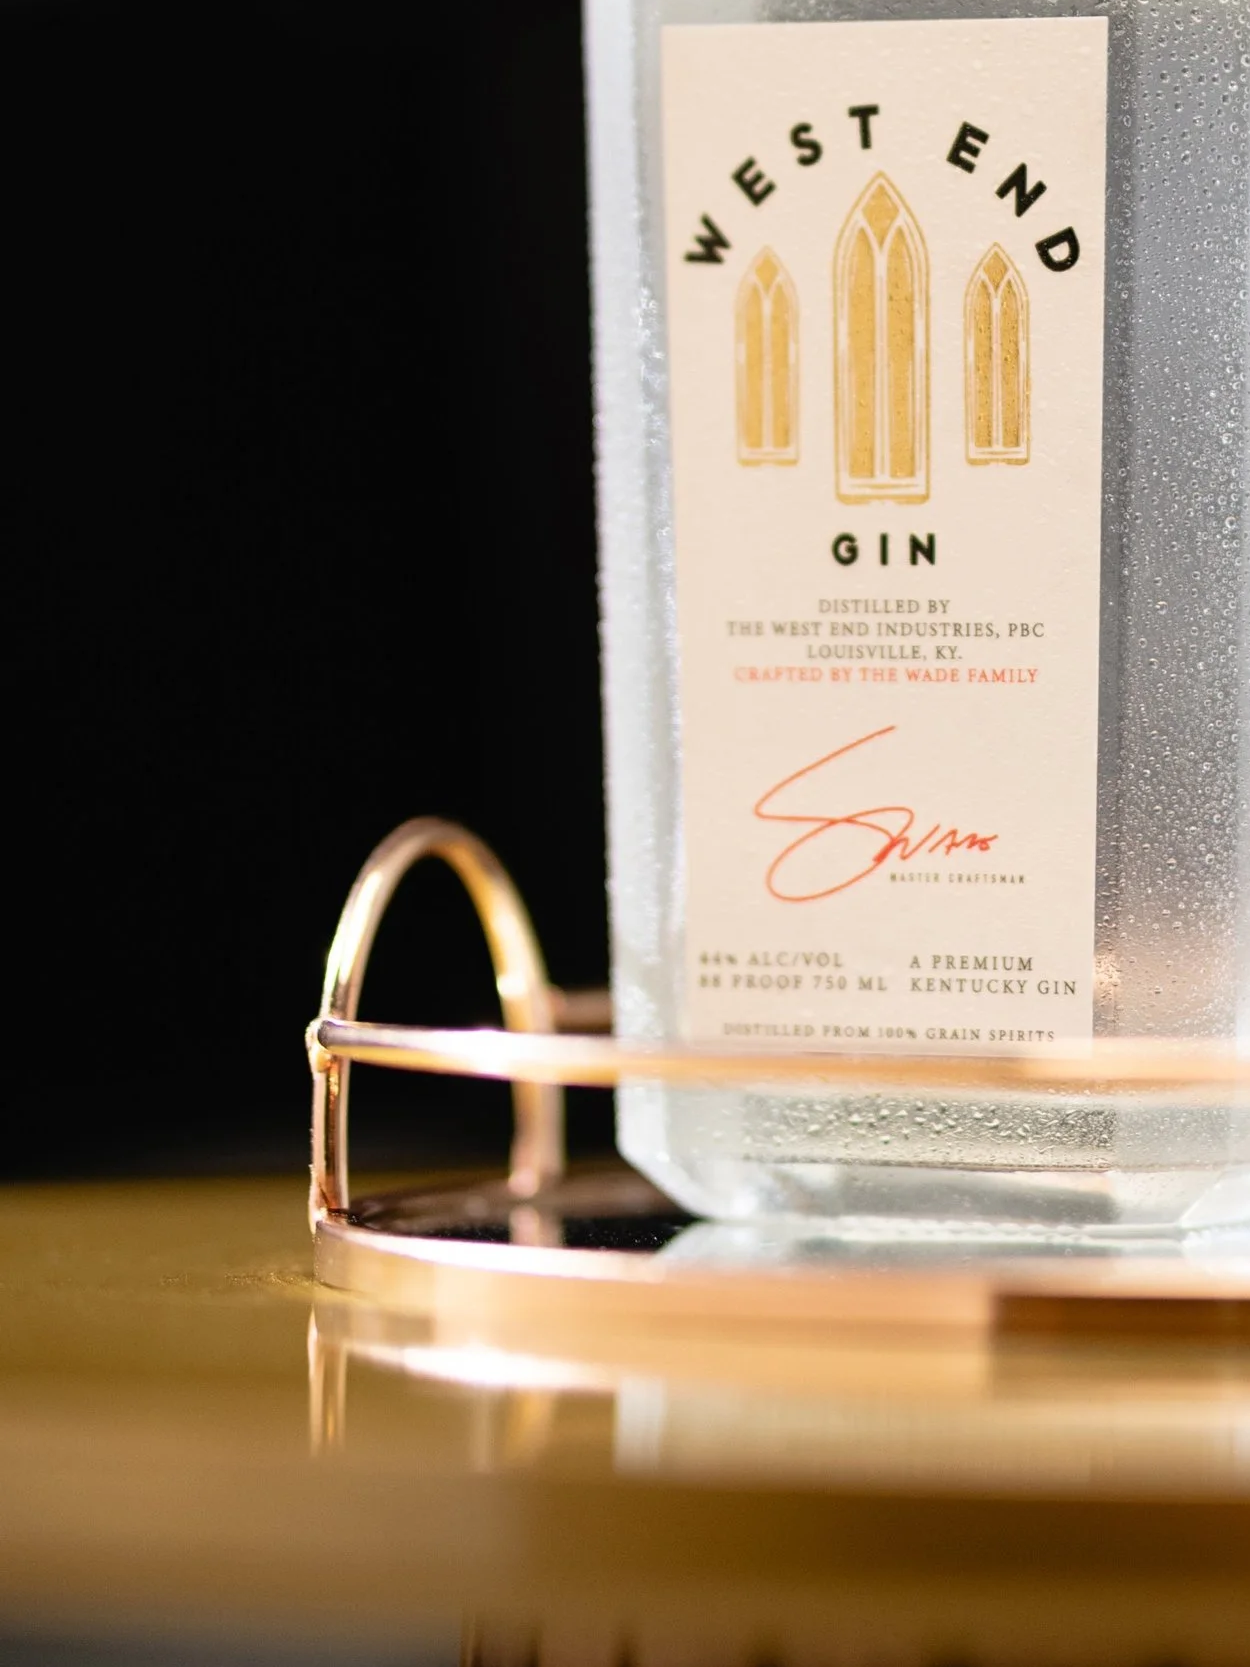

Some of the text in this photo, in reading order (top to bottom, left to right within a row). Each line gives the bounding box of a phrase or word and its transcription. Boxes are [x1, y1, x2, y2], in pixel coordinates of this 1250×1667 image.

[684, 103, 1081, 273] WEST END
[831, 532, 937, 566] GIN
[818, 599, 950, 614] DISTILLED BY
[727, 621, 1045, 640] THE WEST END INDUSTRIES, PBC
[807, 645, 963, 661] LOUISVILLE, KY.
[733, 666, 1039, 684] CRAFTED BY THE WADE FAMILY
[890, 872, 1026, 885] MASTER CRAFTSMAN
[748, 951, 844, 969] ALC/VOL
[910, 955, 1034, 972] A PREMIUM
[732, 975, 804, 990] PROOF
[813, 975, 848, 991] 750
[858, 976, 889, 992] ML
[910, 979, 1078, 996] KENTUCKY GIN
[723, 1022, 1055, 1043] DISTILLED FROM 100% GRAIN SPIRITS
